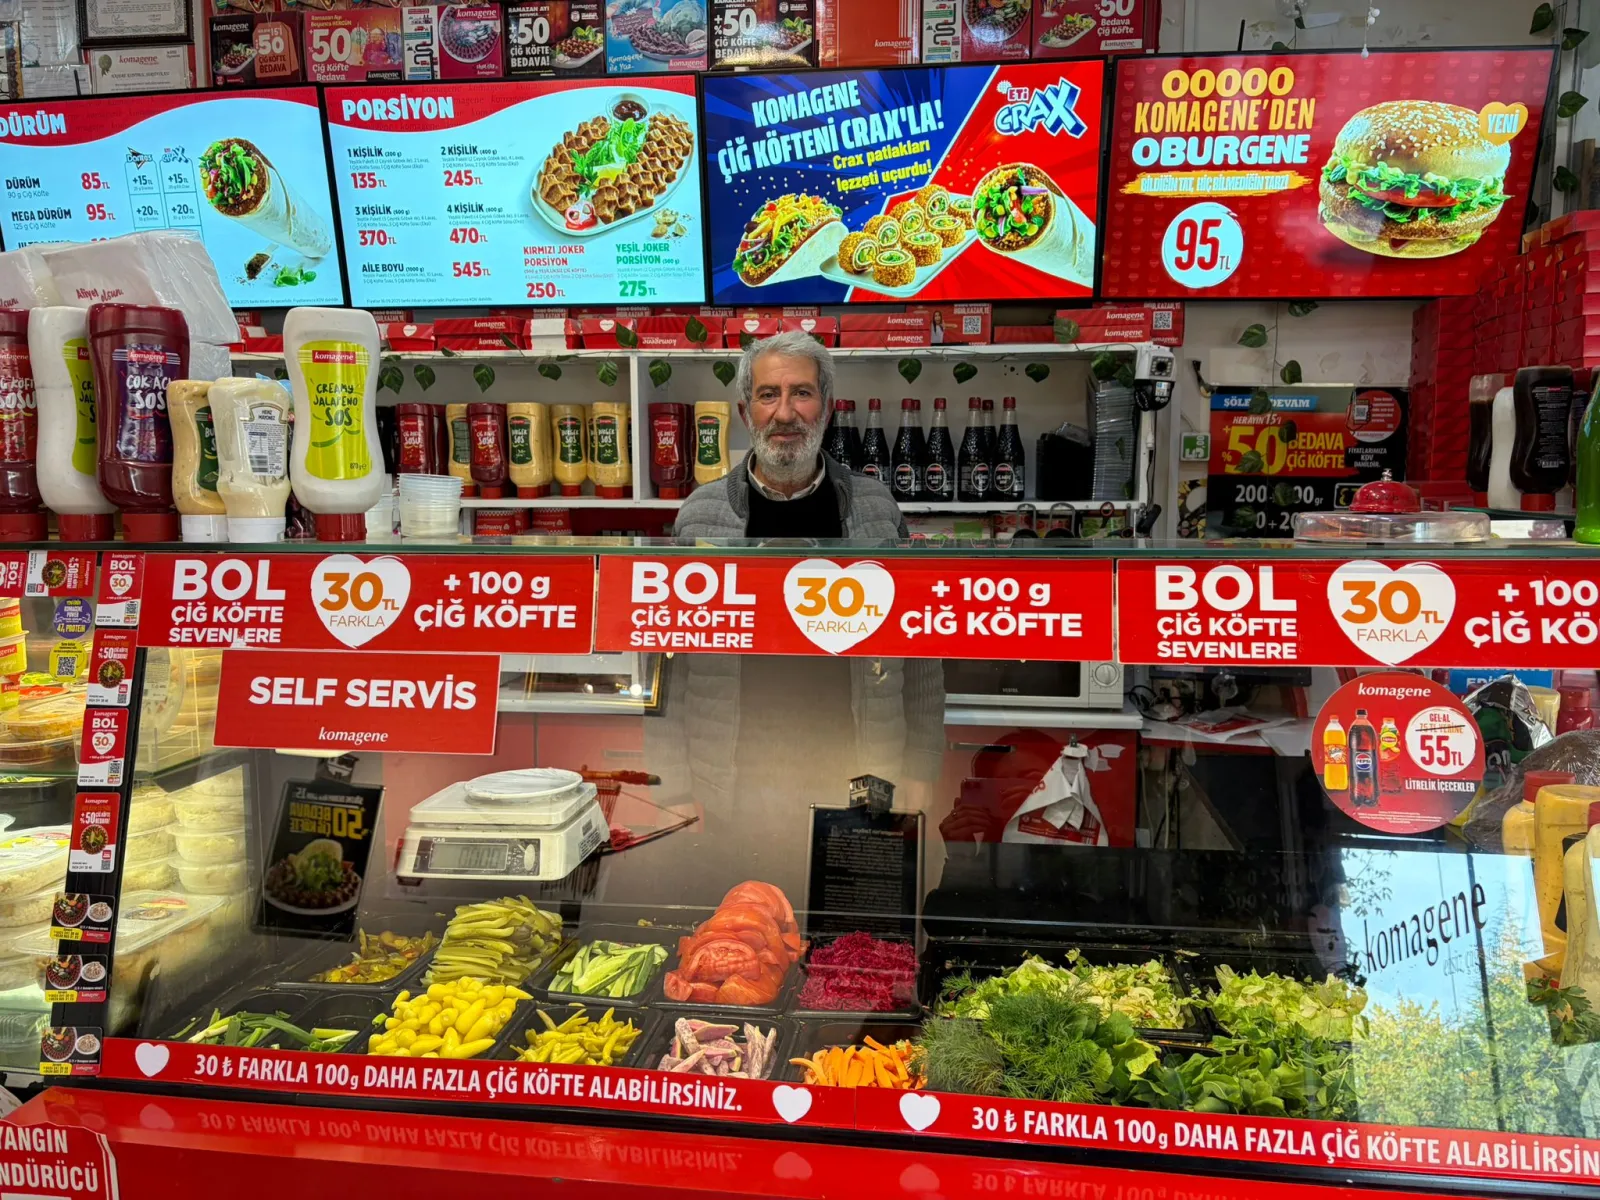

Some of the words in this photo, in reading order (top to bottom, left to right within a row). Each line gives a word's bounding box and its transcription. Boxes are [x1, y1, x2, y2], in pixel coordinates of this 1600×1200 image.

[456, 9, 497, 19] komagene
[723, 8, 757, 36] 50
[1101, 18, 1130, 26] Bedava
[213, 22, 249, 32] komagene
[517, 16, 550, 45] 50
[1097, 26, 1110, 37] Çiğ
[1111, 26, 1134, 35] Köfte
[258, 34, 284, 55] 50
[312, 27, 352, 62] 50
[510, 44, 524, 57] ÇİĞ
[525, 44, 550, 55] KÖFTE
[714, 37, 730, 48] ÇİĞ
[731, 36, 757, 47] KÖFTE
[874, 39, 912, 49] komagene
[119, 54, 158, 64] komagene
[260, 63, 287, 73] BEDAVA
[312, 64, 326, 73] Çiğ
[327, 63, 349, 72] Köfte
[510, 56, 550, 68] BEDAVA!
[669, 59, 704, 68] komagene
[316, 73, 346, 81] Bedava
[1162, 67, 1295, 99] OOOOO
[342, 93, 454, 122] PORSİYON
[751, 79, 861, 128] KOMAGENE
[994, 76, 1089, 139] CRAX
[0, 110, 67, 137] DÜRÜM
[1134, 97, 1316, 134] KOMAGENE'DEN
[1486, 109, 1521, 134] YENİ
[448, 144, 479, 157] KİŞİLİK
[717, 141, 752, 184] ÇİĞ
[752, 121, 839, 169] KÖFTENİ
[841, 99, 944, 152] CRAX'LA!
[1131, 134, 1311, 167] OBURGENE
[353, 146, 384, 158] KİŞİLİK
[833, 151, 864, 170] Crax
[866, 138, 931, 169] patlakları
[5, 176, 41, 190] DÜRÜM
[81, 172, 110, 190] 85TL
[351, 172, 387, 189] 135TL
[443, 169, 483, 187] 245TL
[836, 173, 880, 192] lezzeti
[881, 160, 933, 187] uçurdu!
[11, 211, 36, 222] MEGA
[37, 207, 72, 221] DÜRÜM
[86, 203, 116, 221] 95TL
[362, 203, 392, 216] KİŞİLİK
[454, 202, 484, 214] KİŞİLİK
[40, 221, 56, 229] Köfte
[359, 229, 397, 246] 370TL
[449, 227, 488, 244] 470TL
[523, 246, 556, 255] KIRMIZI
[557, 245, 585, 254] JOKER
[616, 243, 640, 254] YEŞİL
[642, 243, 670, 252] JOKER
[1174, 219, 1231, 271] 95TL
[362, 262, 380, 272] AİLE
[382, 263, 404, 272] BOYU
[524, 257, 568, 266] PORSİYON
[616, 254, 660, 265] PORSİYON
[453, 261, 491, 278] 545TL
[76, 288, 99, 300] Afiyet
[526, 282, 566, 298] 250TL
[619, 280, 658, 297] 275TL
[474, 321, 506, 329] komagene
[887, 315, 924, 326] komagene
[1106, 311, 1145, 321] komagene
[887, 333, 924, 344] komagene
[1104, 329, 1143, 338] komagene
[129, 352, 165, 362] komagene
[314, 351, 354, 363] komagene
[316, 382, 354, 395] CREAMY
[135, 390, 166, 410] SOS
[313, 395, 358, 407] JALAPENO
[1271, 399, 1311, 408] DEVAM
[325, 407, 353, 427] SOS
[514, 436, 525, 444] SOS
[565, 436, 577, 444] SOS
[601, 436, 612, 444] SOS
[702, 436, 714, 444] SOS
[1288, 432, 1345, 450] BEDAVA
[1224, 425, 1288, 475] 50
[1286, 452, 1306, 471] ÇİĞ
[1307, 451, 1345, 469] KÖFTE
[1235, 485, 1267, 503] 200
[1315, 498, 1324, 506] gr
[110, 560, 136, 571] BOL
[7, 561, 19, 589] BOL
[172, 559, 286, 601] BOL
[630, 561, 757, 605] BOL
[319, 572, 400, 612] 30TL
[444, 575, 461, 592] +
[468, 571, 523, 595] 100
[531, 575, 550, 600] g
[931, 580, 951, 598] +
[958, 577, 1019, 601] 100
[1028, 582, 1051, 605] g
[1155, 565, 1298, 612] BOL
[1498, 583, 1519, 602] +
[1529, 580, 1598, 608] 100
[793, 577, 884, 619] 30TL
[1341, 579, 1445, 625] 30TL
[171, 601, 209, 625] ÇİĞ
[212, 602, 283, 623] KÖFTE
[329, 614, 385, 628] FARKLA
[413, 597, 466, 632] ÇİĞ
[474, 600, 577, 629] KÖFTE
[630, 606, 671, 630] ÇİĞ
[676, 606, 755, 628] KÖFTE
[806, 620, 869, 634] FARKLA
[899, 605, 957, 640] ÇİĞ
[967, 607, 1083, 637] KÖFTE
[1156, 613, 1202, 638] ÇİĞ
[1208, 613, 1297, 637] KÖFTE
[1464, 611, 1530, 649] ÇİĞ
[168, 626, 281, 644] SEVENLERE
[629, 630, 754, 649] SEVENLERE
[1356, 628, 1429, 643] FARKLA
[1156, 640, 1298, 660] SEVENLERE
[249, 677, 338, 705] SELF
[345, 673, 476, 710] SERVİS
[1358, 683, 1431, 700] komagene
[92, 718, 118, 729] BOL
[318, 726, 389, 744] komagene
[1420, 735, 1465, 767] 55TL
[1405, 779, 1437, 791] LİTRELİK
[1437, 780, 1475, 793] İÇECEKLER
[1364, 883, 1487, 973] komagene
[194, 1054, 218, 1076] 30
[222, 1056, 234, 1078] ₺
[238, 1057, 308, 1084] FARKLA
[314, 1063, 359, 1090] 100g
[363, 1066, 417, 1090] DAHA
[422, 1068, 481, 1093] FAZLA
[486, 1066, 518, 1098] ÇİĞ
[523, 1067, 585, 1097] KÖFTE
[588, 1074, 743, 1112] ALABİLİRSİNİZ.
[0, 1126, 69, 1154] ANGIN
[971, 1106, 999, 1131] 30
[1004, 1109, 1017, 1133] ₺
[1024, 1110, 1108, 1141] FARKLA
[1114, 1118, 1168, 1149] 100g
[1174, 1122, 1238, 1151] DAHA
[1244, 1127, 1316, 1157] FAZLA
[1321, 1128, 1360, 1164] ÇİĞ
[1368, 1131, 1441, 1164] KÖFTE
[1446, 1138, 1600, 1177] ALABİLİRSİN
[0, 1157, 99, 1192] NDÜRÜCÜ
